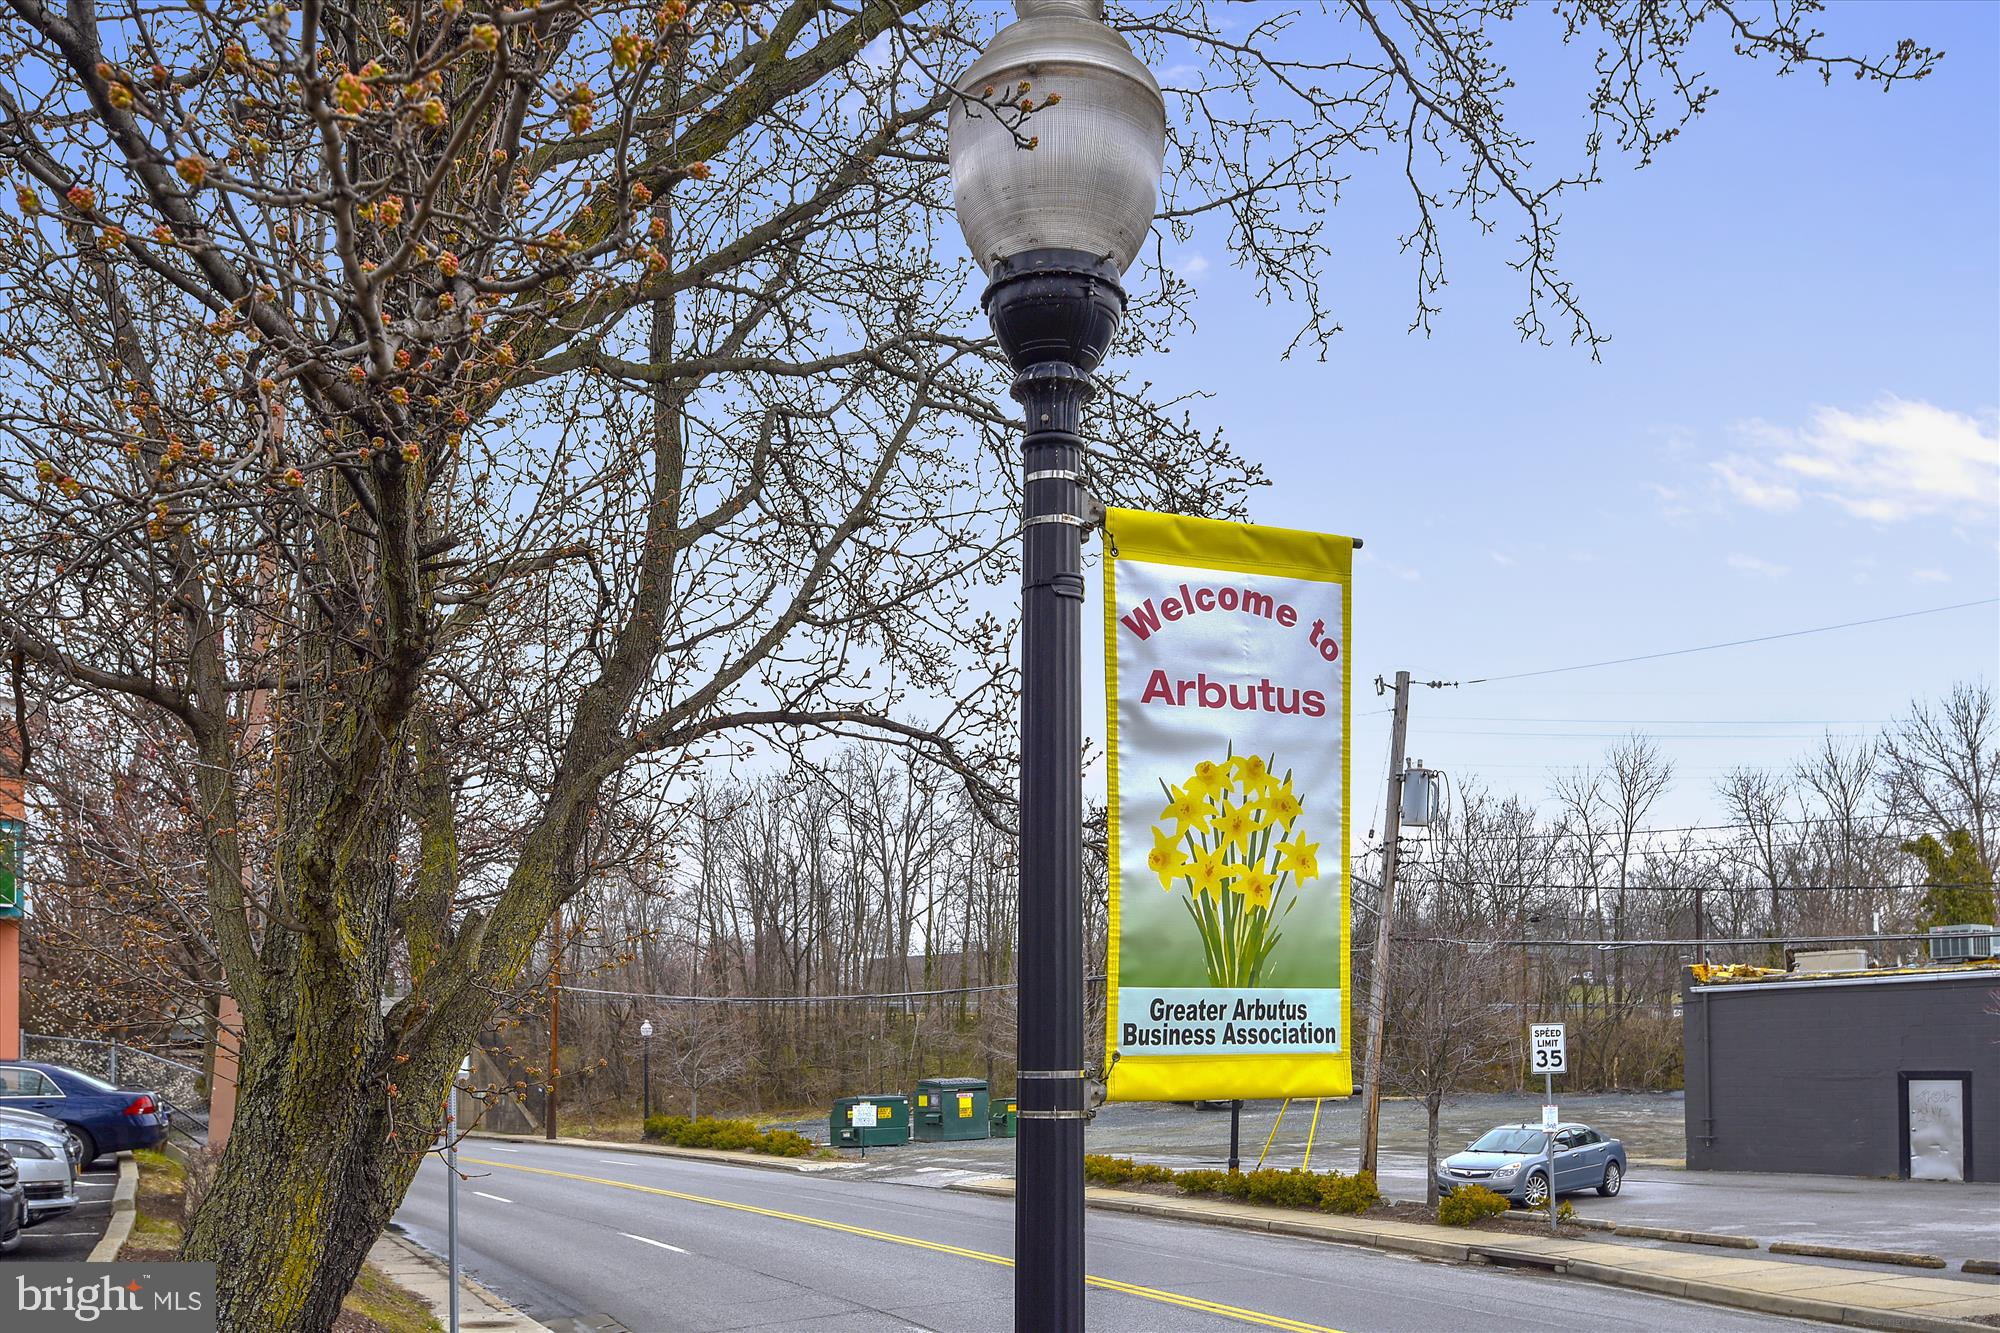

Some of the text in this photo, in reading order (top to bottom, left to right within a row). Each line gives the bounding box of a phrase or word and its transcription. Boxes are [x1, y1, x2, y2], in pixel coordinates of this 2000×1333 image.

[1120, 584, 1339, 662] Welcome to
[1141, 669, 1326, 717] Arbutus
[1150, 998, 1308, 1021] Greater Arbutus
[1123, 1022, 1336, 1046] Business Association
[1534, 1029, 1561, 1037] SPEED
[1537, 1039, 1558, 1047] LIMIT
[1536, 1050, 1562, 1067] 35
